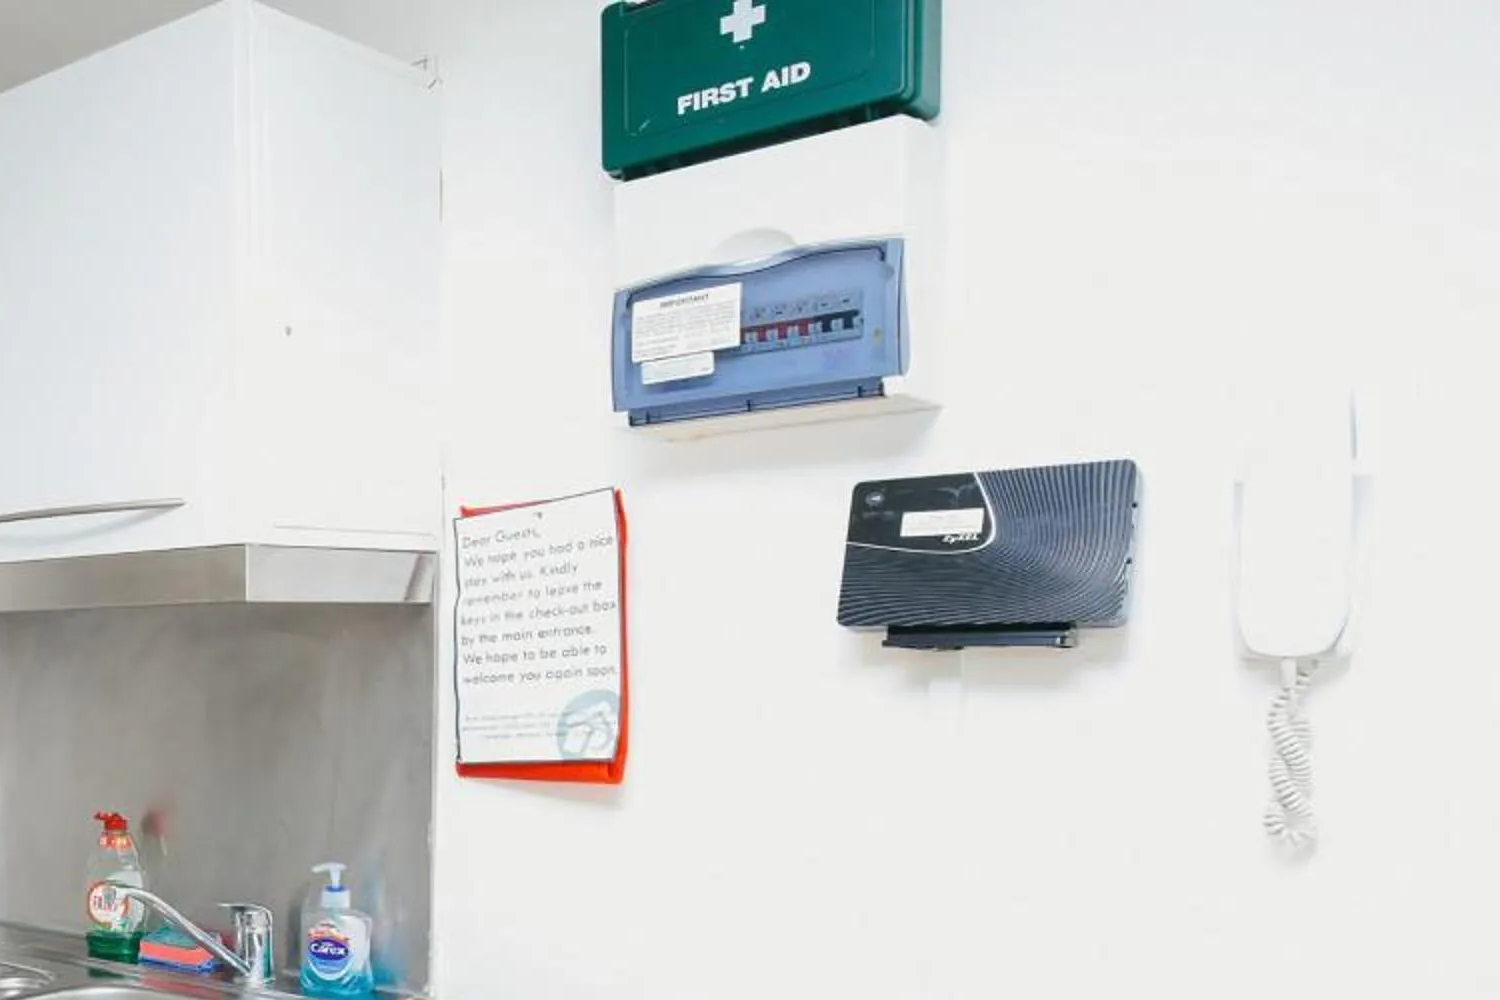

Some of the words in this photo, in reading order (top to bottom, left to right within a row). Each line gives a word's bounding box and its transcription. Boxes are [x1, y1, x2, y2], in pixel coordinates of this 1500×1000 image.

[677, 76, 754, 116] FIRST
[761, 61, 812, 94] AID
[462, 536, 491, 549] Dear
[464, 556, 484, 567] We
[488, 552, 517, 565] hope
[524, 548, 545, 560] you
[549, 542, 573, 555] had
[577, 541, 585, 550] a
[590, 535, 613, 548] nice
[465, 577, 487, 589] stay
[492, 570, 516, 583] with
[539, 561, 578, 576] Kindly
[464, 592, 523, 606] remember
[528, 587, 541, 599] to
[546, 584, 579, 596] leave
[583, 580, 603, 591] the
[461, 615, 486, 627] keys
[490, 612, 500, 622] in
[504, 609, 523, 620] the
[529, 602, 589, 619] check-out
[592, 600, 616, 613] box
[461, 636, 475, 647] by
[479, 633, 498, 644] the
[502, 630, 533, 642] main
[463, 653, 483, 665] We
[485, 651, 519, 664] hope
[523, 650, 536, 660] to
[540, 648, 557, 659] be
[561, 645, 591, 657] able
[594, 644, 607, 655] to
[464, 672, 515, 685] welcome
[520, 671, 542, 683] you
[546, 667, 583, 680] again
